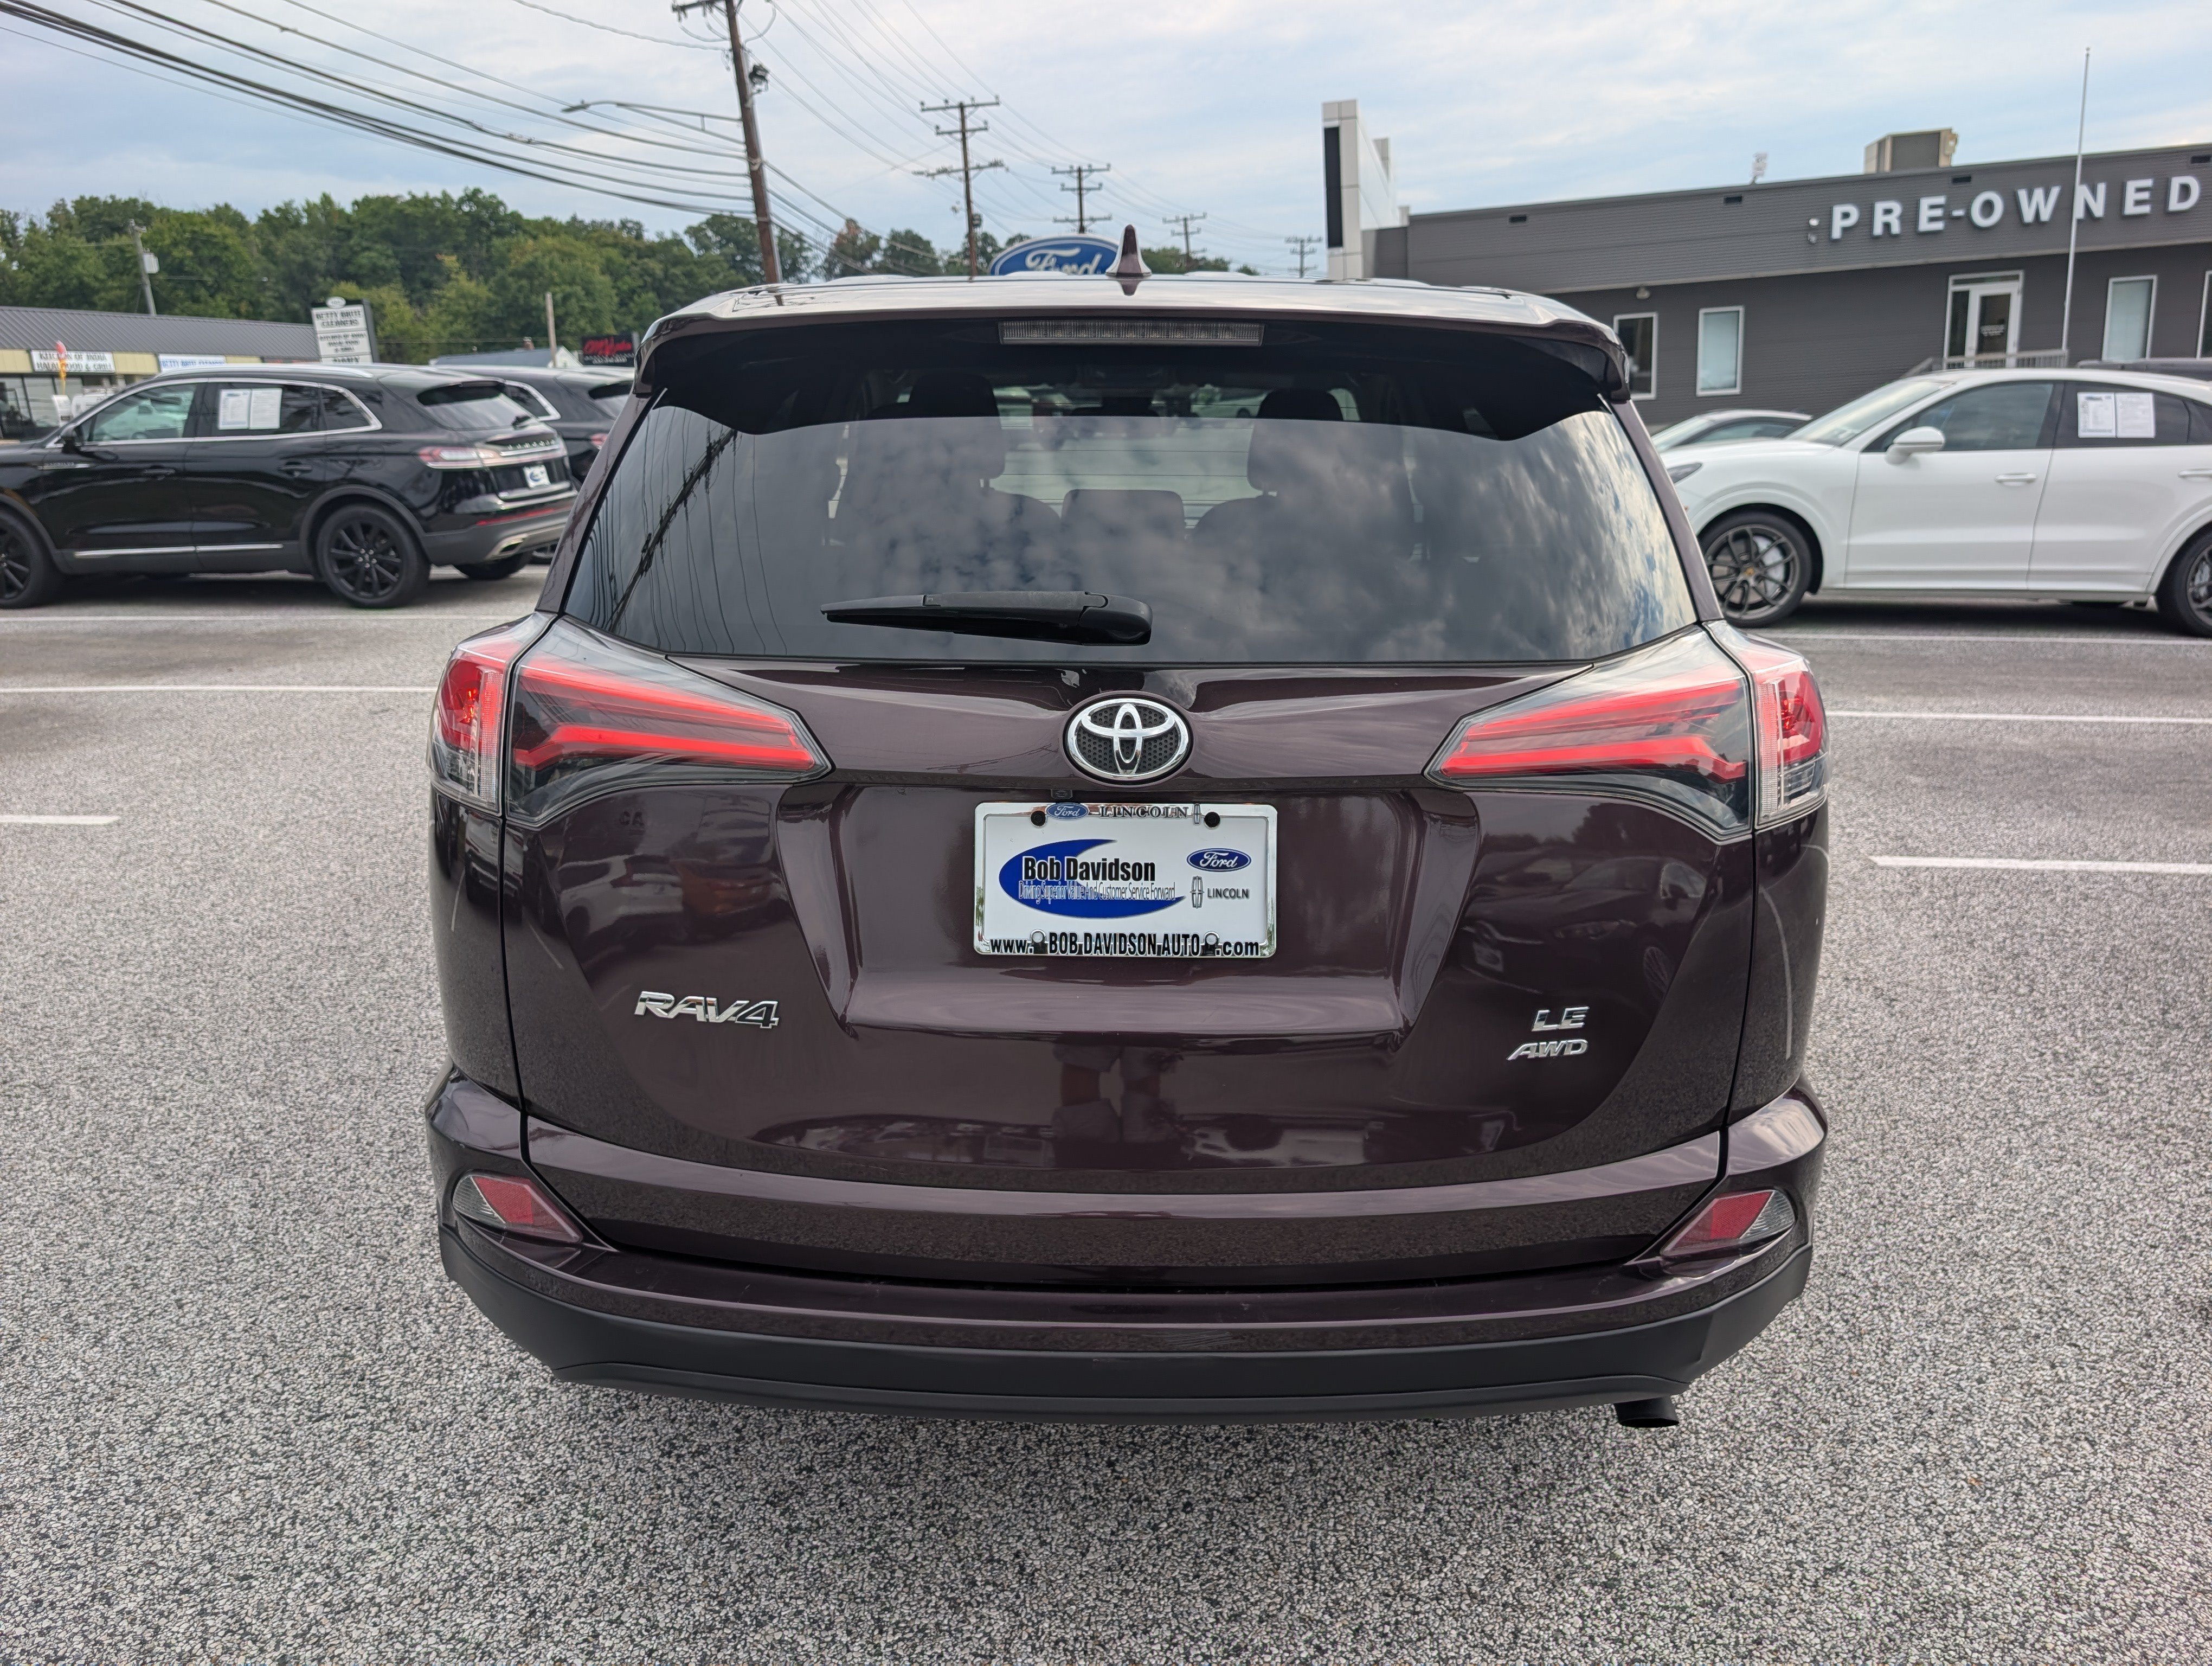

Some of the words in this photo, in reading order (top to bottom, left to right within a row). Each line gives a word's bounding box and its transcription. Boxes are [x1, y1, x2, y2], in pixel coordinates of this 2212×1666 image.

[1830, 175, 2201, 240] PRE-OWNED
[39, 351, 73, 361] KITCN
[65, 362, 83, 371] OOD
[1053, 805, 1081, 817] Ford
[1099, 805, 1189, 818] LINCOLN
[1024, 857, 1061, 881] Bob
[1066, 857, 1155, 881] Davidson
[1199, 851, 1238, 868] Ford
[1019, 880, 1041, 905] Driving
[1041, 880, 1067, 905] Superior
[1066, 881, 1084, 900] Value
[1084, 881, 1098, 900] And
[1098, 881, 1128, 900] Customer
[1128, 882, 1150, 900] Service
[1150, 881, 1175, 900] Forward
[1207, 888, 1250, 899] LINCOLN
[1049, 932, 1078, 954] BOB
[1083, 932, 1157, 956] DAVIDSON
[1161, 933, 1200, 956] AUTO
[634, 991, 780, 1029] RAV4
[1531, 1006, 1590, 1032] LE
[1506, 1039, 1589, 1061] AWD
